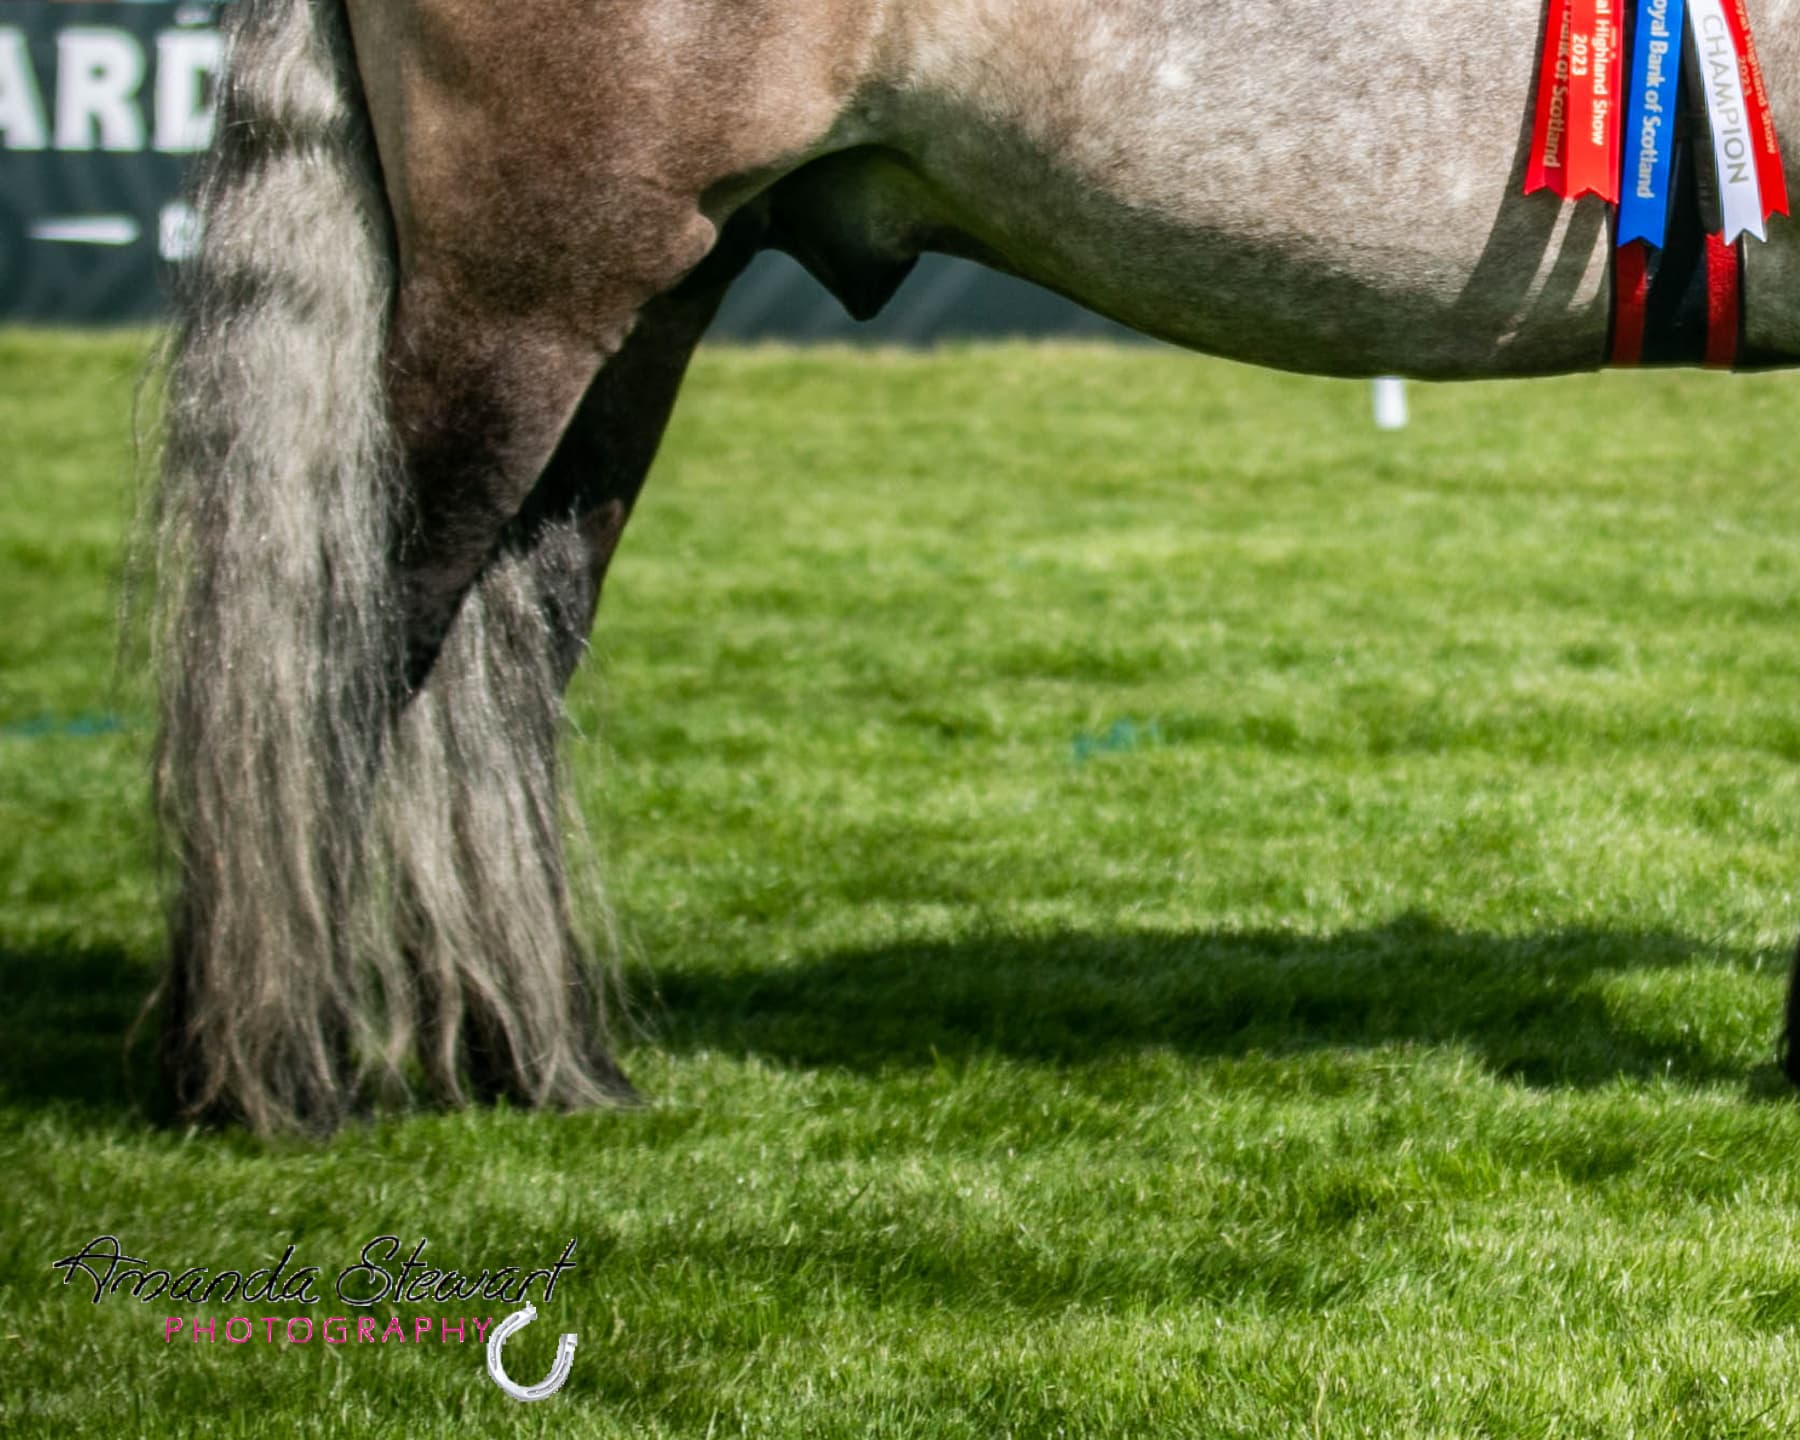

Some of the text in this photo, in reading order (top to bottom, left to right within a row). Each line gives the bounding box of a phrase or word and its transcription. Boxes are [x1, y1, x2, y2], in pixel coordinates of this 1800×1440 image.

[1571, 32, 1588, 77] 2023
[1591, 19, 1611, 96] Highland
[1645, 41, 1669, 88] Bank
[0, 23, 222, 152] ARD
[1644, 90, 1663, 113] of
[1702, 14, 1749, 185] CHAMPION
[1543, 84, 1569, 168] Scotland
[1591, 99, 1609, 147] Show
[1760, 109, 1777, 155] Show
[1637, 115, 1662, 200] Scotland
